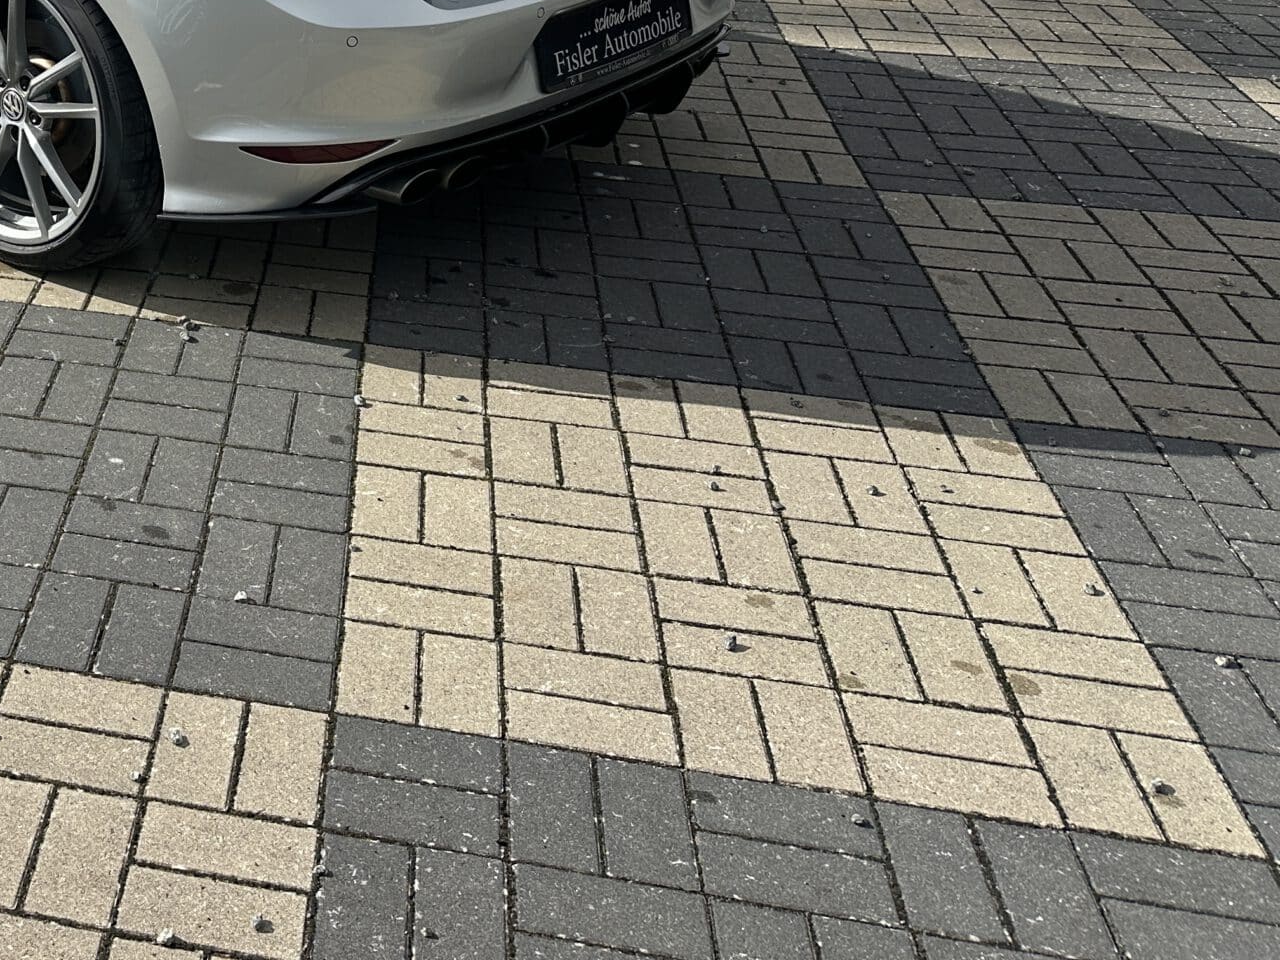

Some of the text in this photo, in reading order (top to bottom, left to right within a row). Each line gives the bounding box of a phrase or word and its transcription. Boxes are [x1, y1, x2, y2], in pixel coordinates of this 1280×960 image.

[553, 6, 682, 77] Fisler Automobile
[593, 7, 626, 33] schöne
